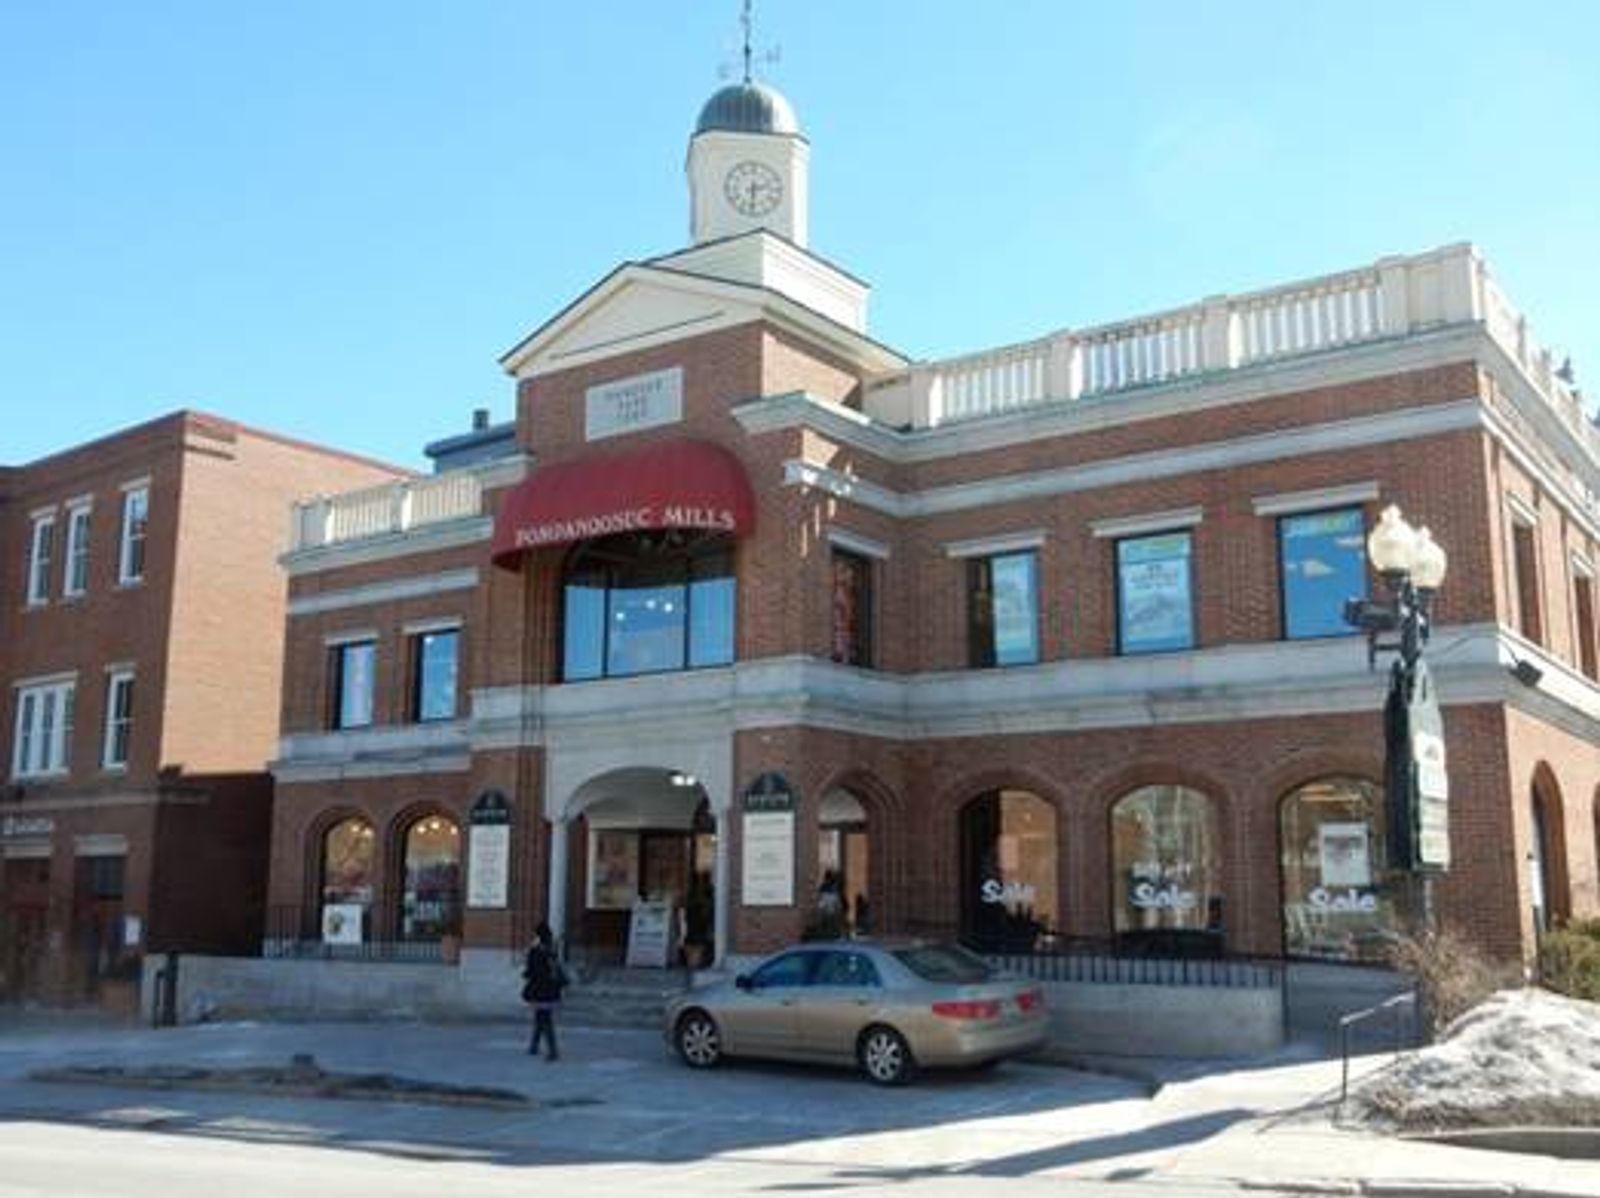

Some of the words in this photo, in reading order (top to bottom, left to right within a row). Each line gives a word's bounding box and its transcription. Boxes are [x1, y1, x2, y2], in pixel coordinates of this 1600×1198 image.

[662, 501, 735, 530] MILLS
[1130, 882, 1198, 908] Sale
[1307, 887, 1376, 913] Sale
